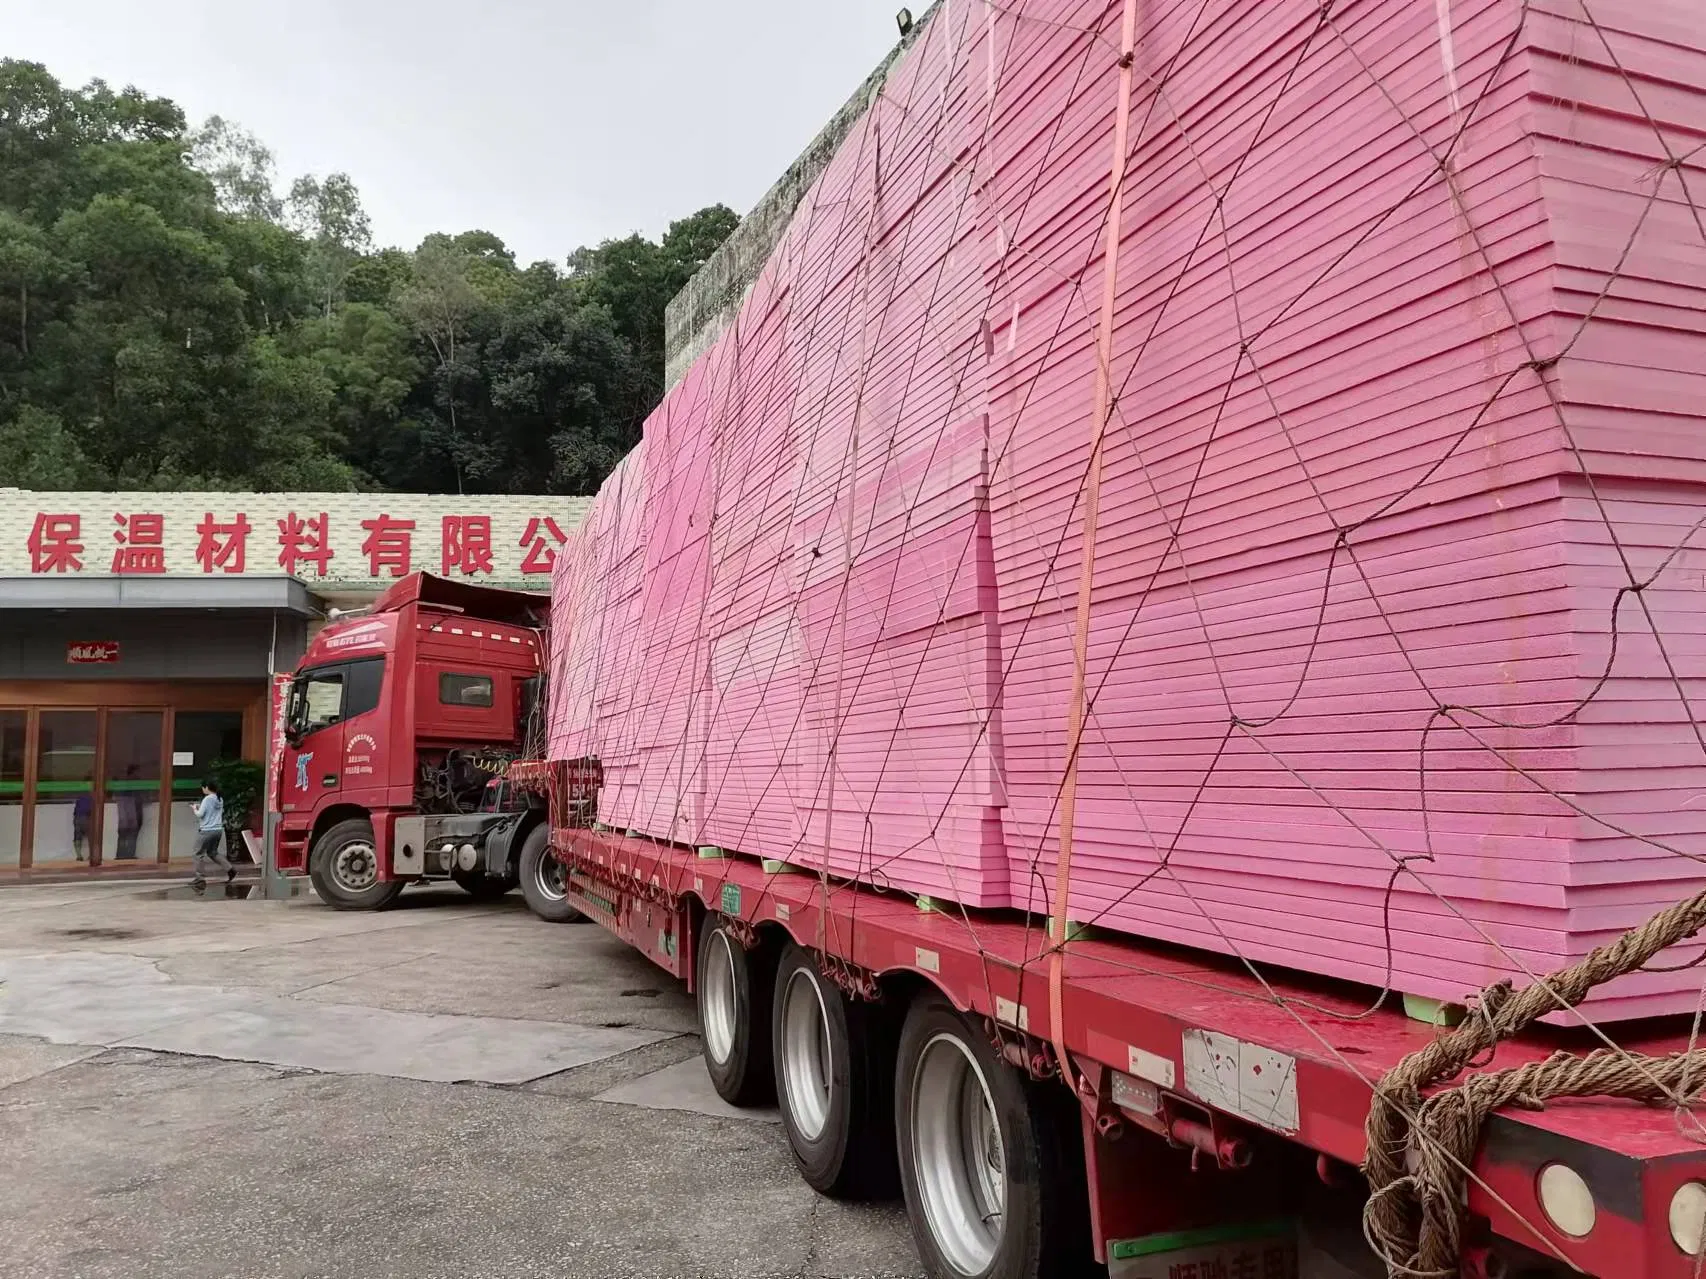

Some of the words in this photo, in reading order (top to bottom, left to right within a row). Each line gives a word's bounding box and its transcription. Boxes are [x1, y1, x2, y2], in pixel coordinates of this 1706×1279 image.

[27, 512, 568, 577] 保温材料有限公
